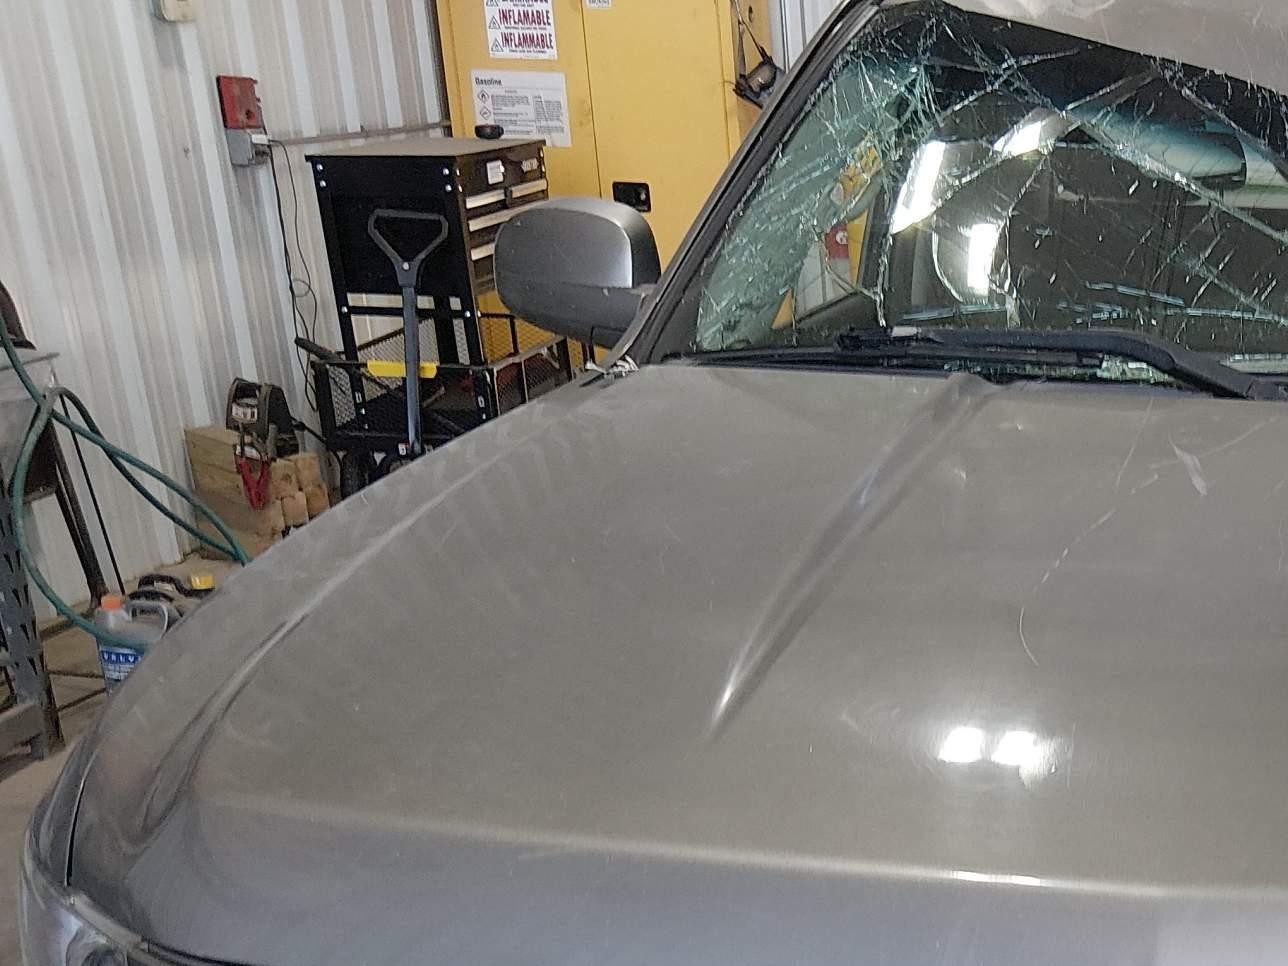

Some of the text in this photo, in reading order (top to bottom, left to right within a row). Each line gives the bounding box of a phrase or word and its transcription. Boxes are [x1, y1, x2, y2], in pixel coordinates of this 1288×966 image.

[499, 9, 551, 25] INFLAMABLE
[501, 31, 553, 49] INFLAMMABLE
[475, 77, 502, 86] Gasoline
